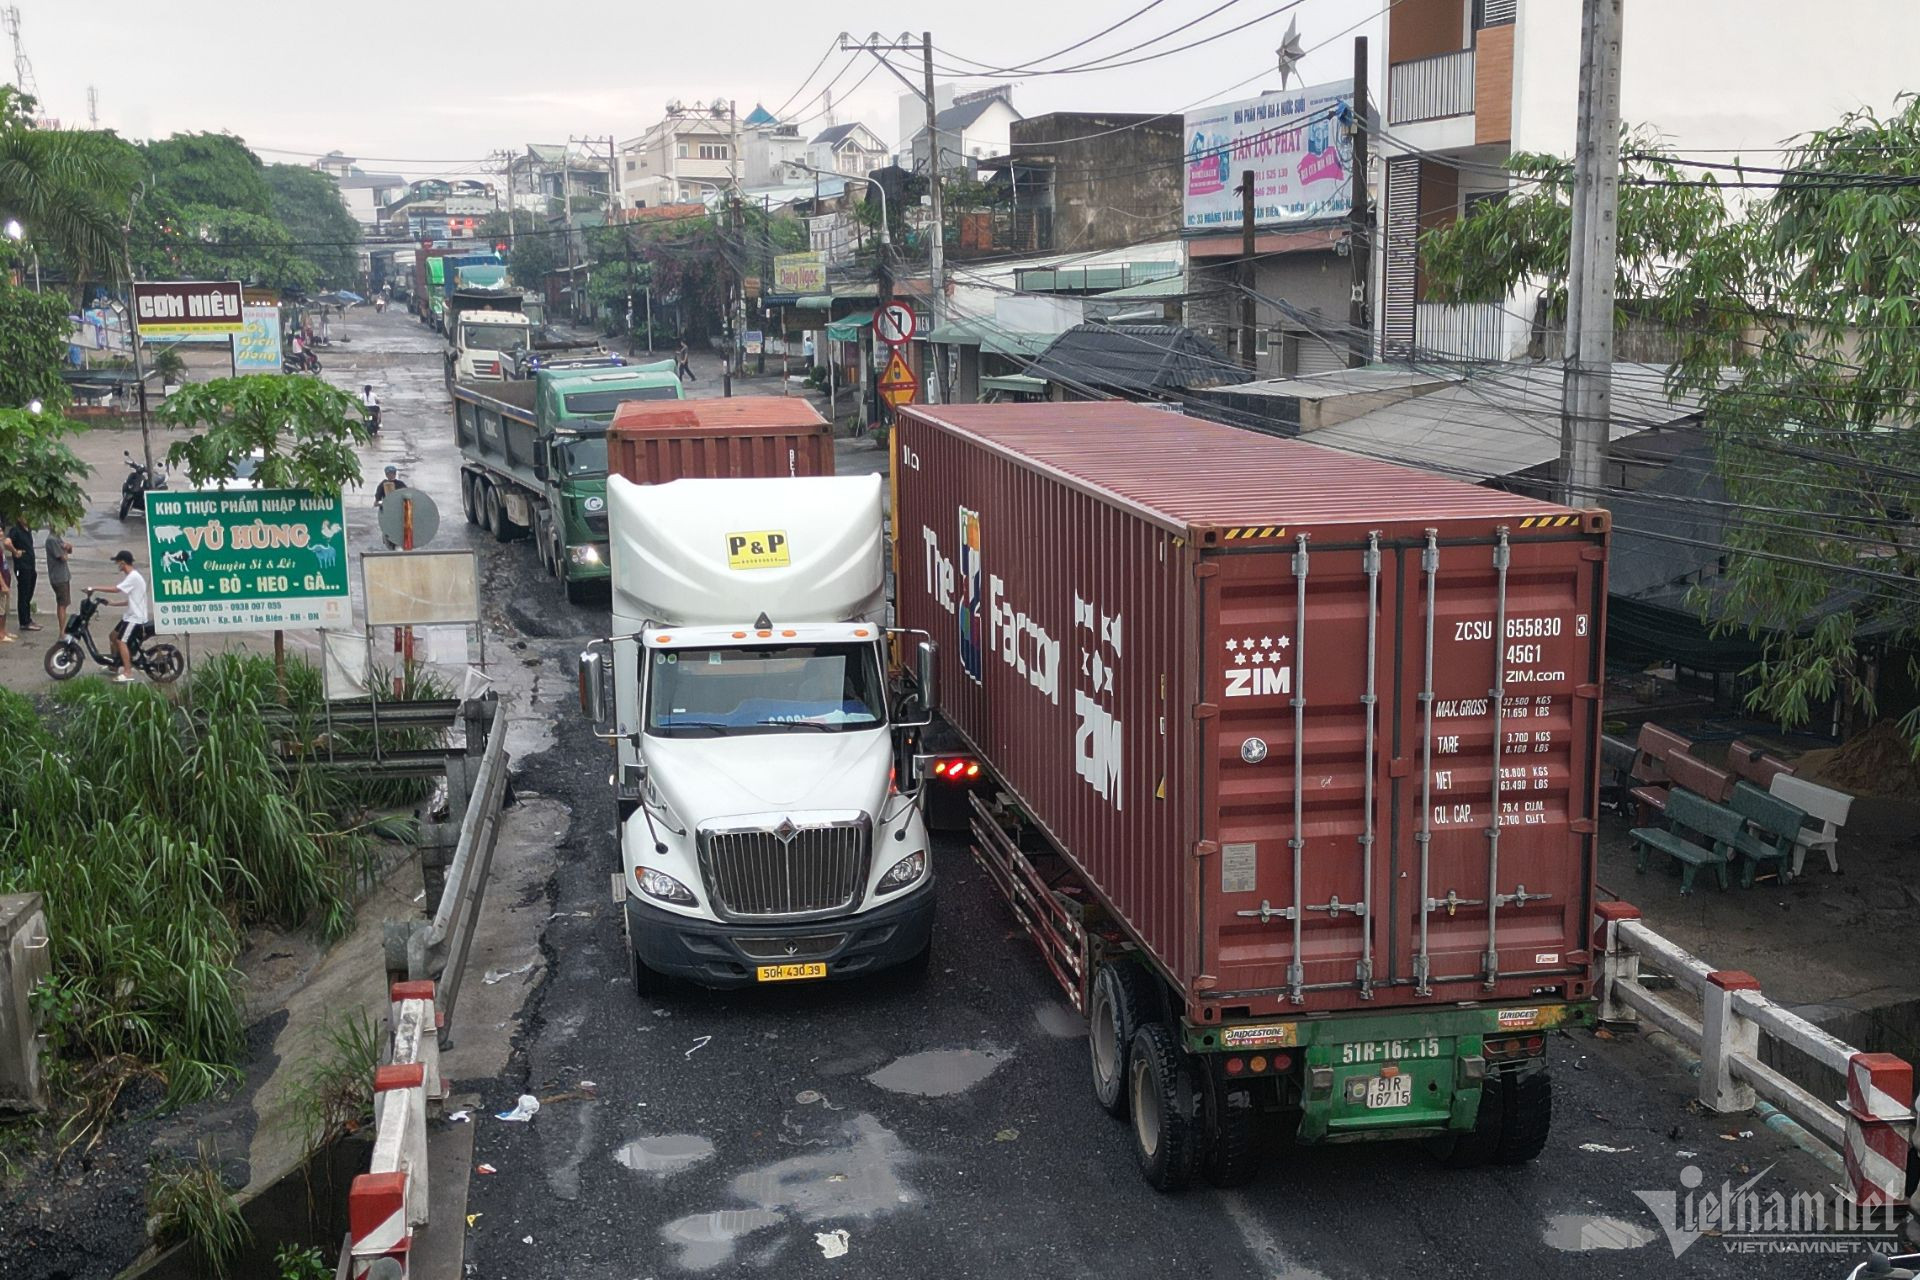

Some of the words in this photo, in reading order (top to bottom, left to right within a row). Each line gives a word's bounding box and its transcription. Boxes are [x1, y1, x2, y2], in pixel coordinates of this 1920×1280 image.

[189, 290, 238, 317] NIÊU
[155, 501, 181, 515] KHO
[185, 500, 217, 516] THỰC
[262, 499, 296, 514] NHẬP
[230, 518, 310, 550] HÙNG
[162, 576, 204, 595] TRÂU
[219, 573, 241, 594] BÒ
[256, 576, 288, 592] HEO
[1454, 620, 1493, 641] ZCSU
[1506, 617, 1561, 638] 655830
[1506, 644, 1541, 663] 45G1
[1225, 666, 1290, 697] ZIM
[1505, 670, 1565, 683] ZIM.com
[1535, 706, 1550, 717] LBS
[1437, 735, 1459, 754] TARE
[1535, 731, 1551, 742] KGS
[1435, 770, 1452, 790] NET
[1532, 766, 1548, 777] KGS
[1534, 779, 1548, 789] LBS
[1434, 805, 1449, 824] CU.
[1453, 804, 1474, 823] CAP.
